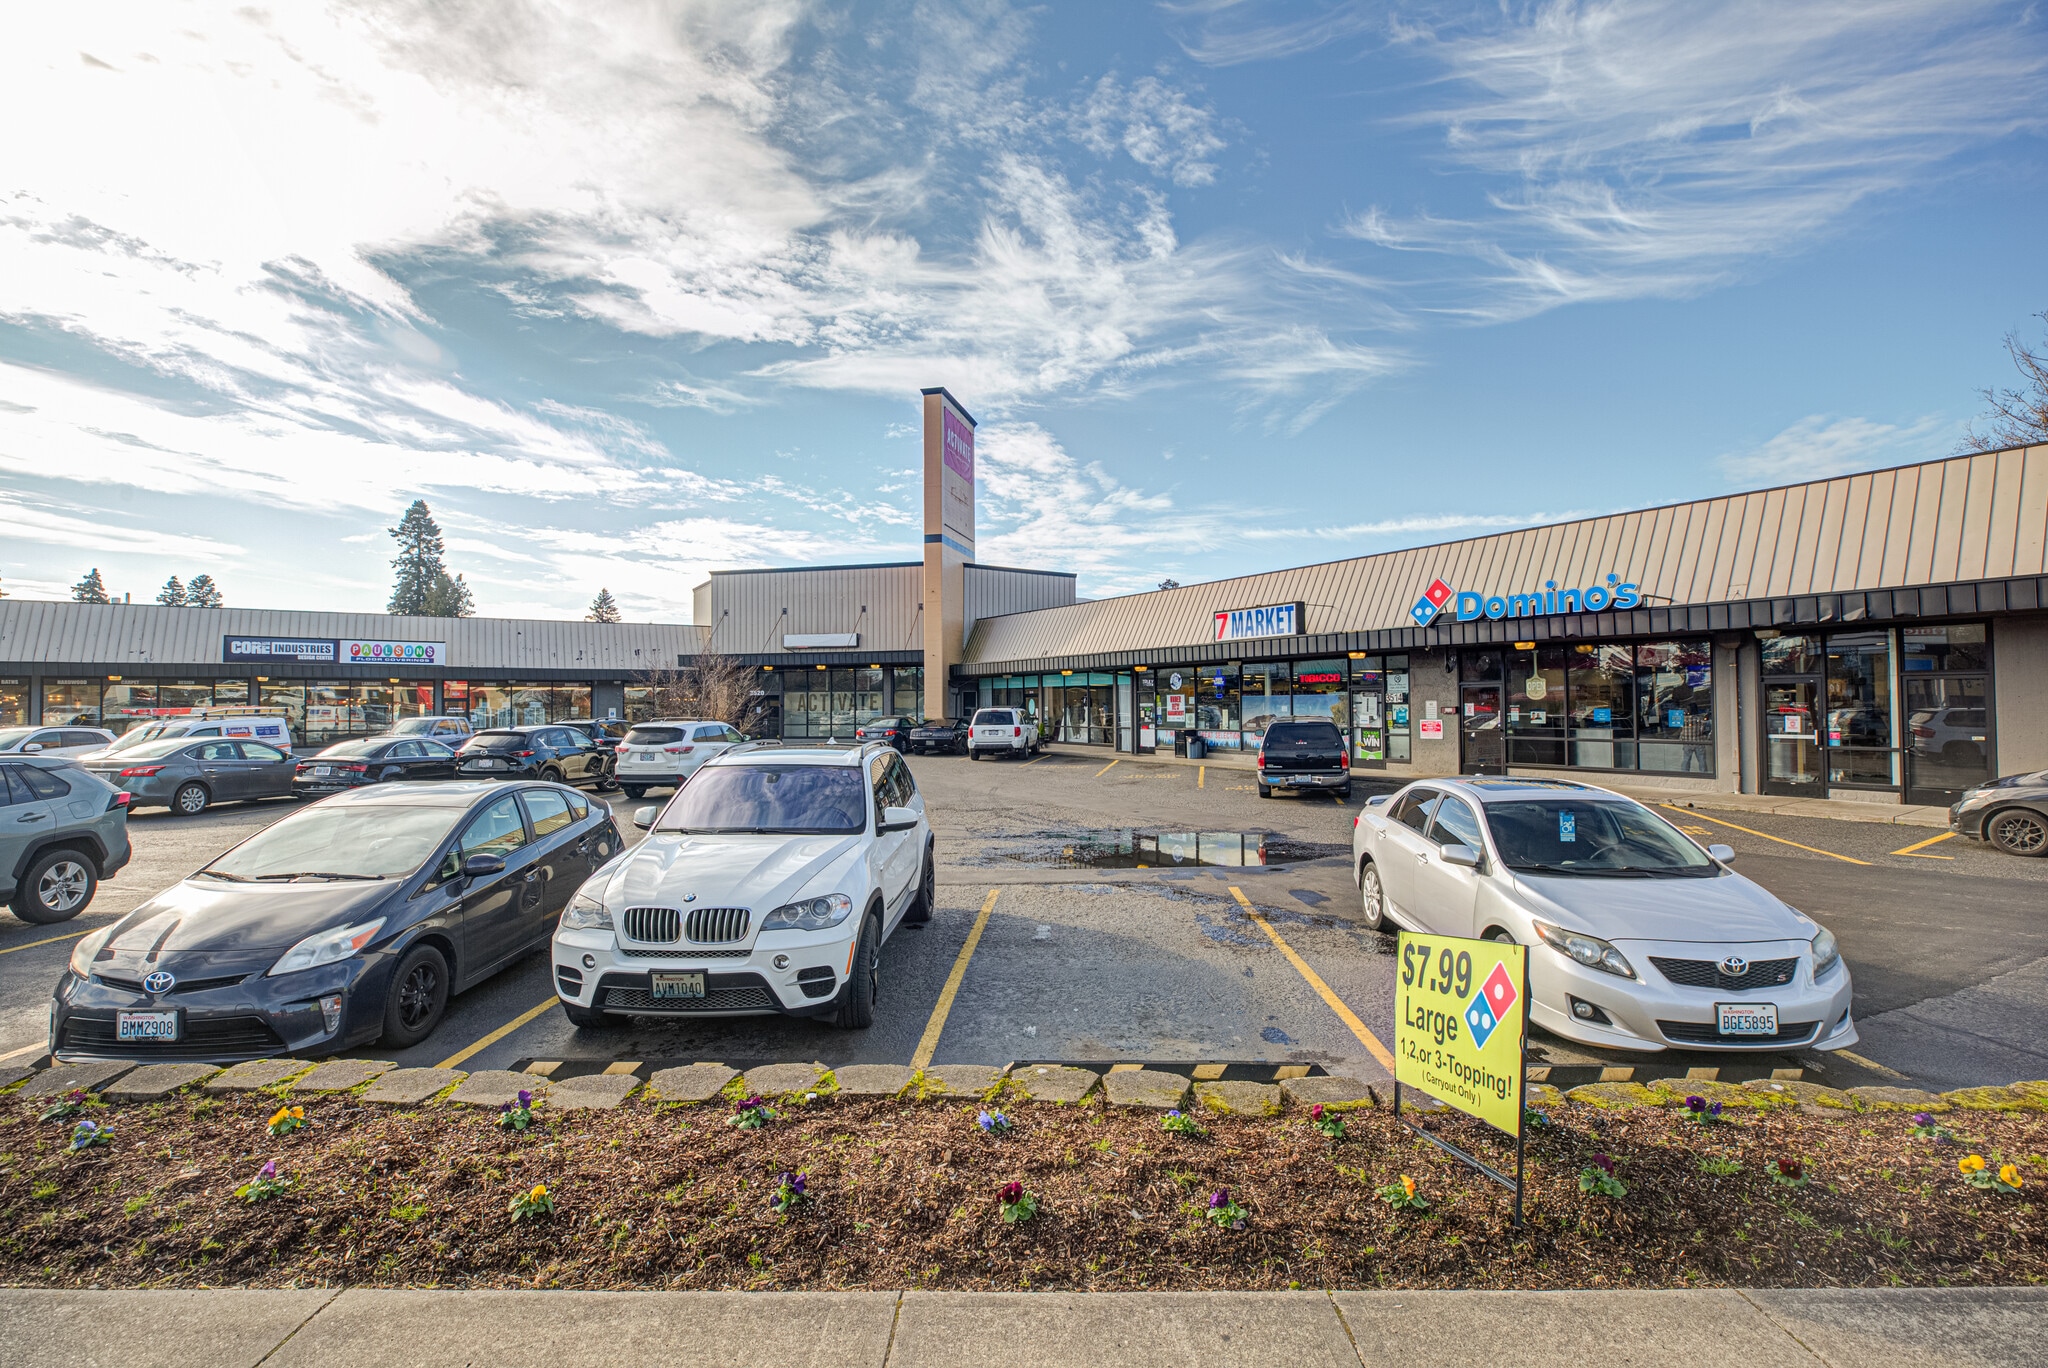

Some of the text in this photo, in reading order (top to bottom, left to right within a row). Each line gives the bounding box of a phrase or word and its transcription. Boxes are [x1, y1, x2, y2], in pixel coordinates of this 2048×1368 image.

[946, 428, 971, 463] ACTIVATE
[1456, 572, 1640, 622] Domino's
[1215, 604, 1294, 640] 7 MARKET
[230, 640, 332, 655] CORE INDUSTRIES
[351, 644, 434, 656] PAULSONS
[1299, 673, 1341, 683] TOBACCO
[1527, 681, 1546, 690] OPEN
[797, 693, 879, 712] ACTIVATE
[1363, 737, 1380, 747] WIN
[1402, 940, 1472, 999] $7.99
[655, 982, 702, 995] AVM1040
[121, 1020, 173, 1036] BMM2908
[1405, 995, 1458, 1046] Large
[1722, 1015, 1774, 1030] BGE5895
[1435, 1049, 1512, 1100] 3-Topping!
[1426, 1072, 1456, 1094] Carryout
[1458, 1085, 1476, 1105] Only
